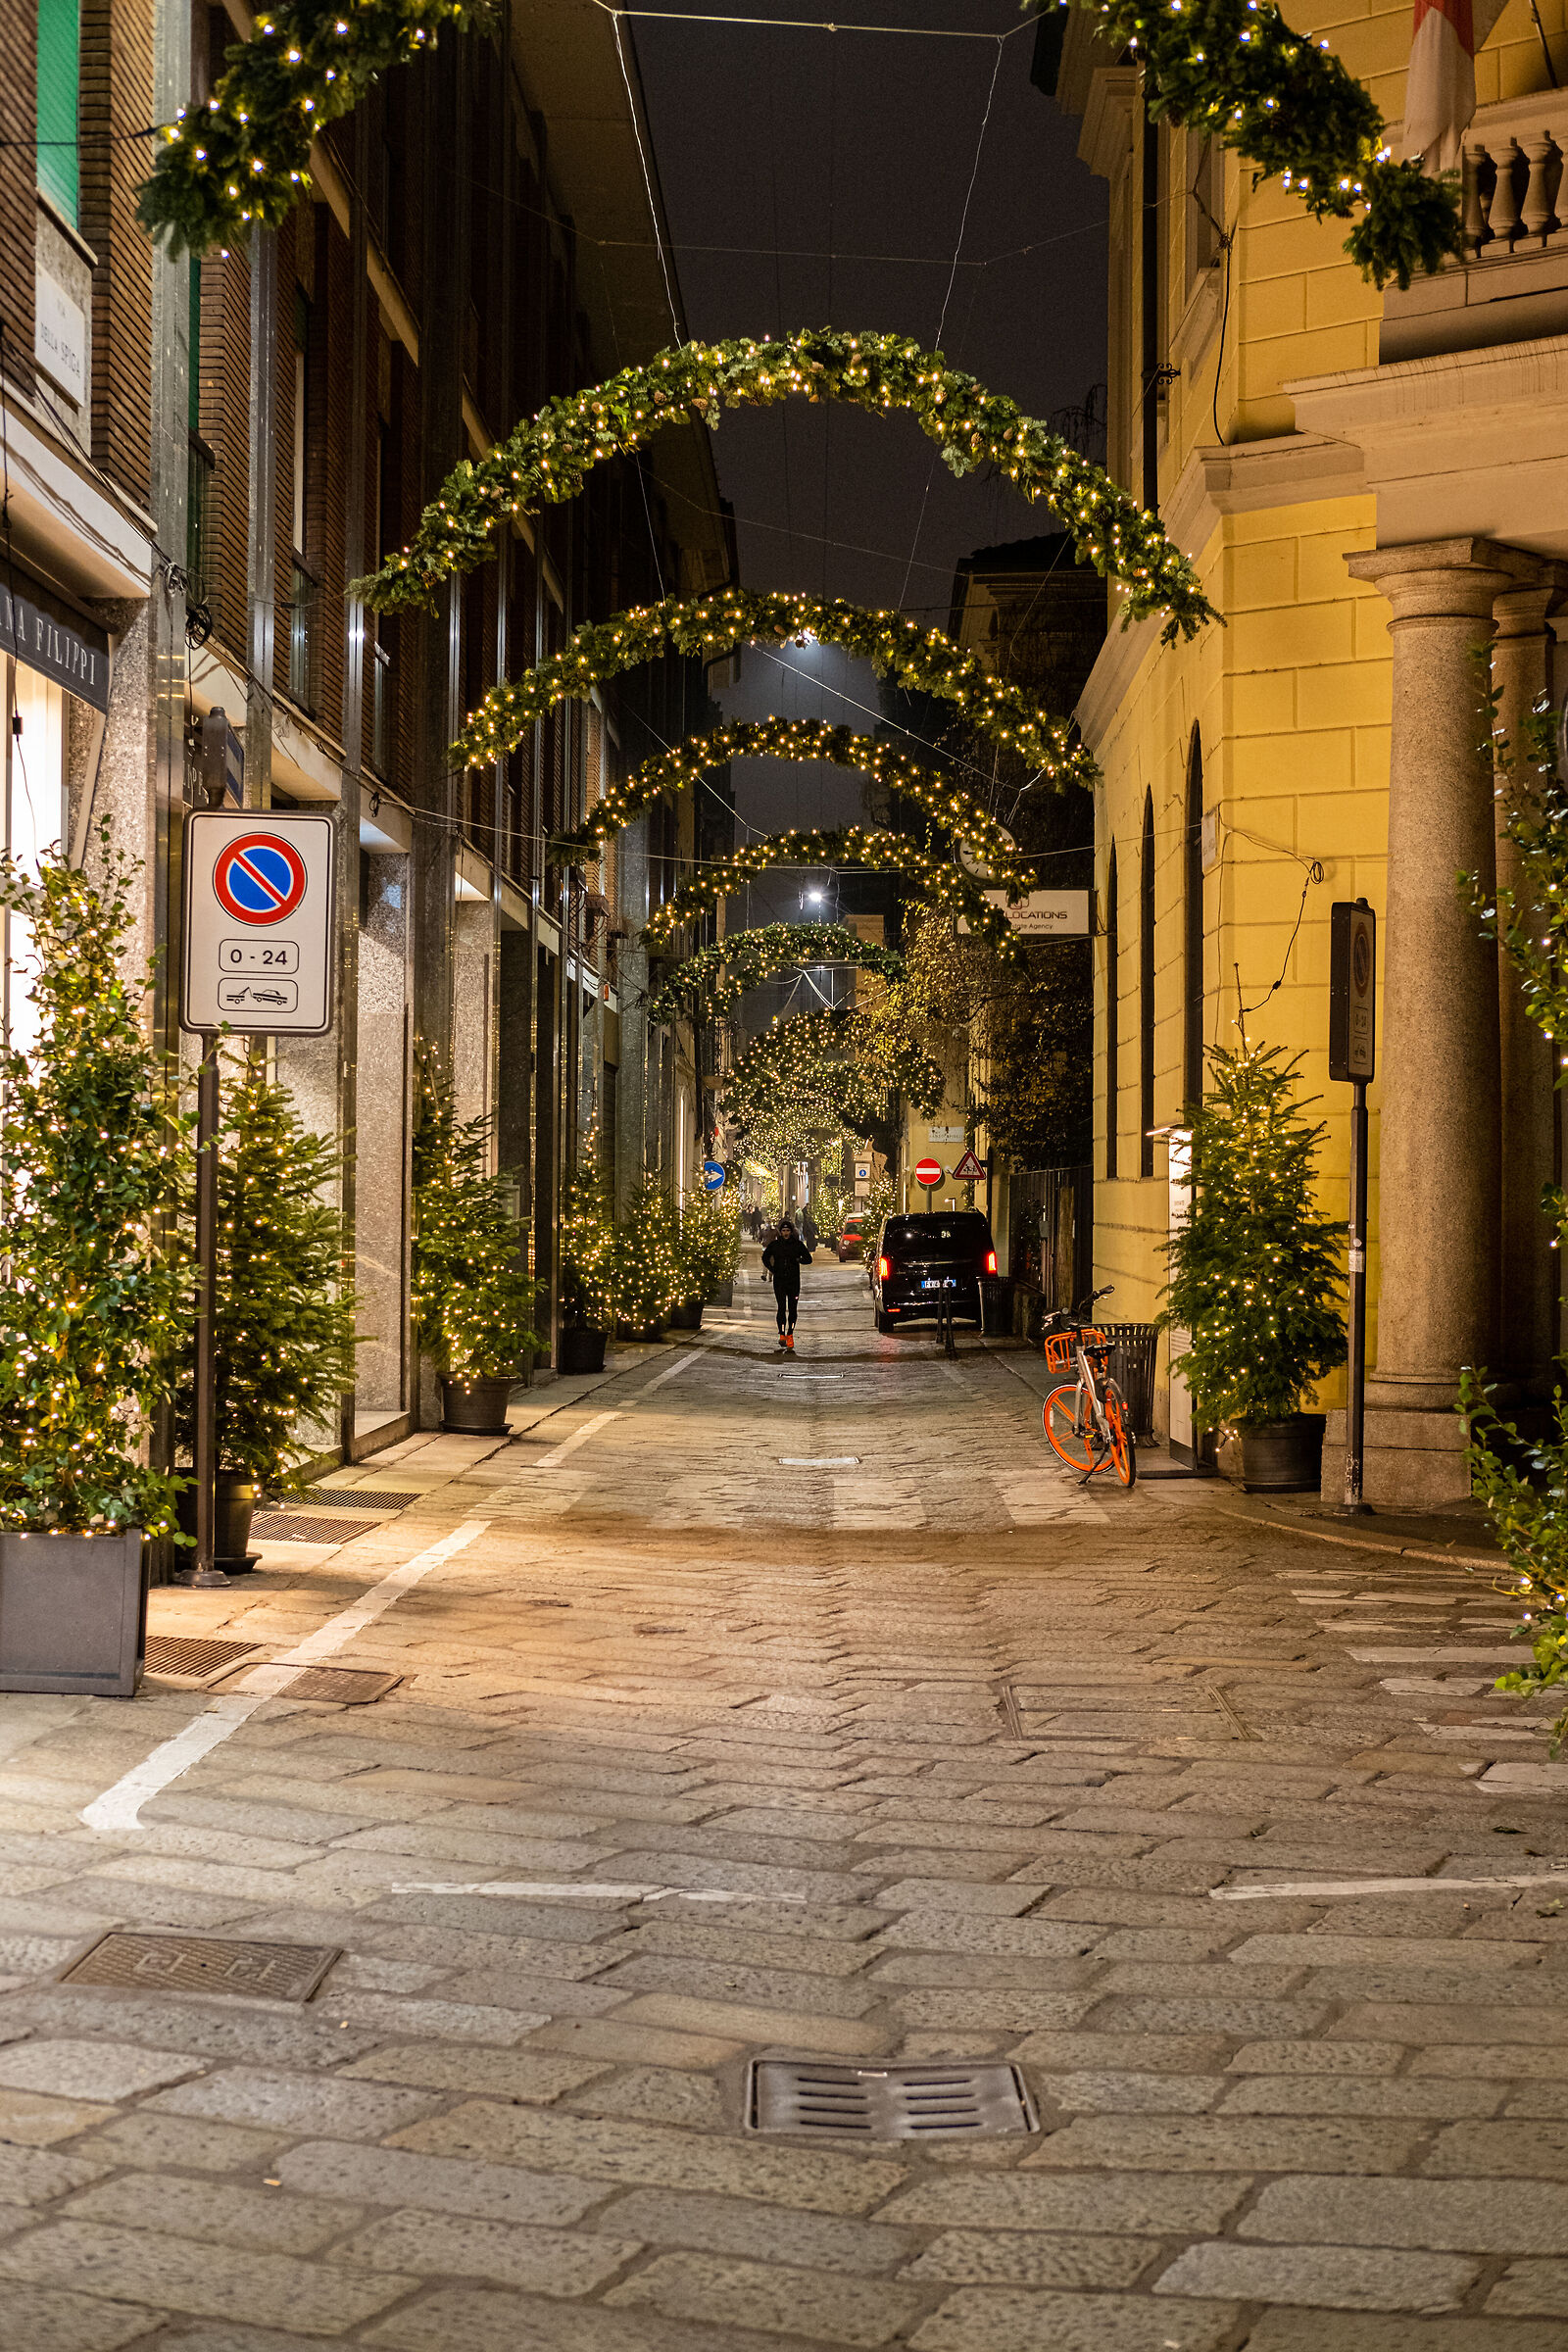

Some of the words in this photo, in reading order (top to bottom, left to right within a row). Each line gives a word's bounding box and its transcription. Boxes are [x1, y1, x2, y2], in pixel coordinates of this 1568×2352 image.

[40, 321, 58, 354] DELLA
[61, 341, 80, 378] SPIGA
[0, 595, 26, 642] NA
[36, 617, 95, 685] FILIPPI
[1005, 910, 1067, 919] LOCATIONS
[263, 950, 287, 965] 24
